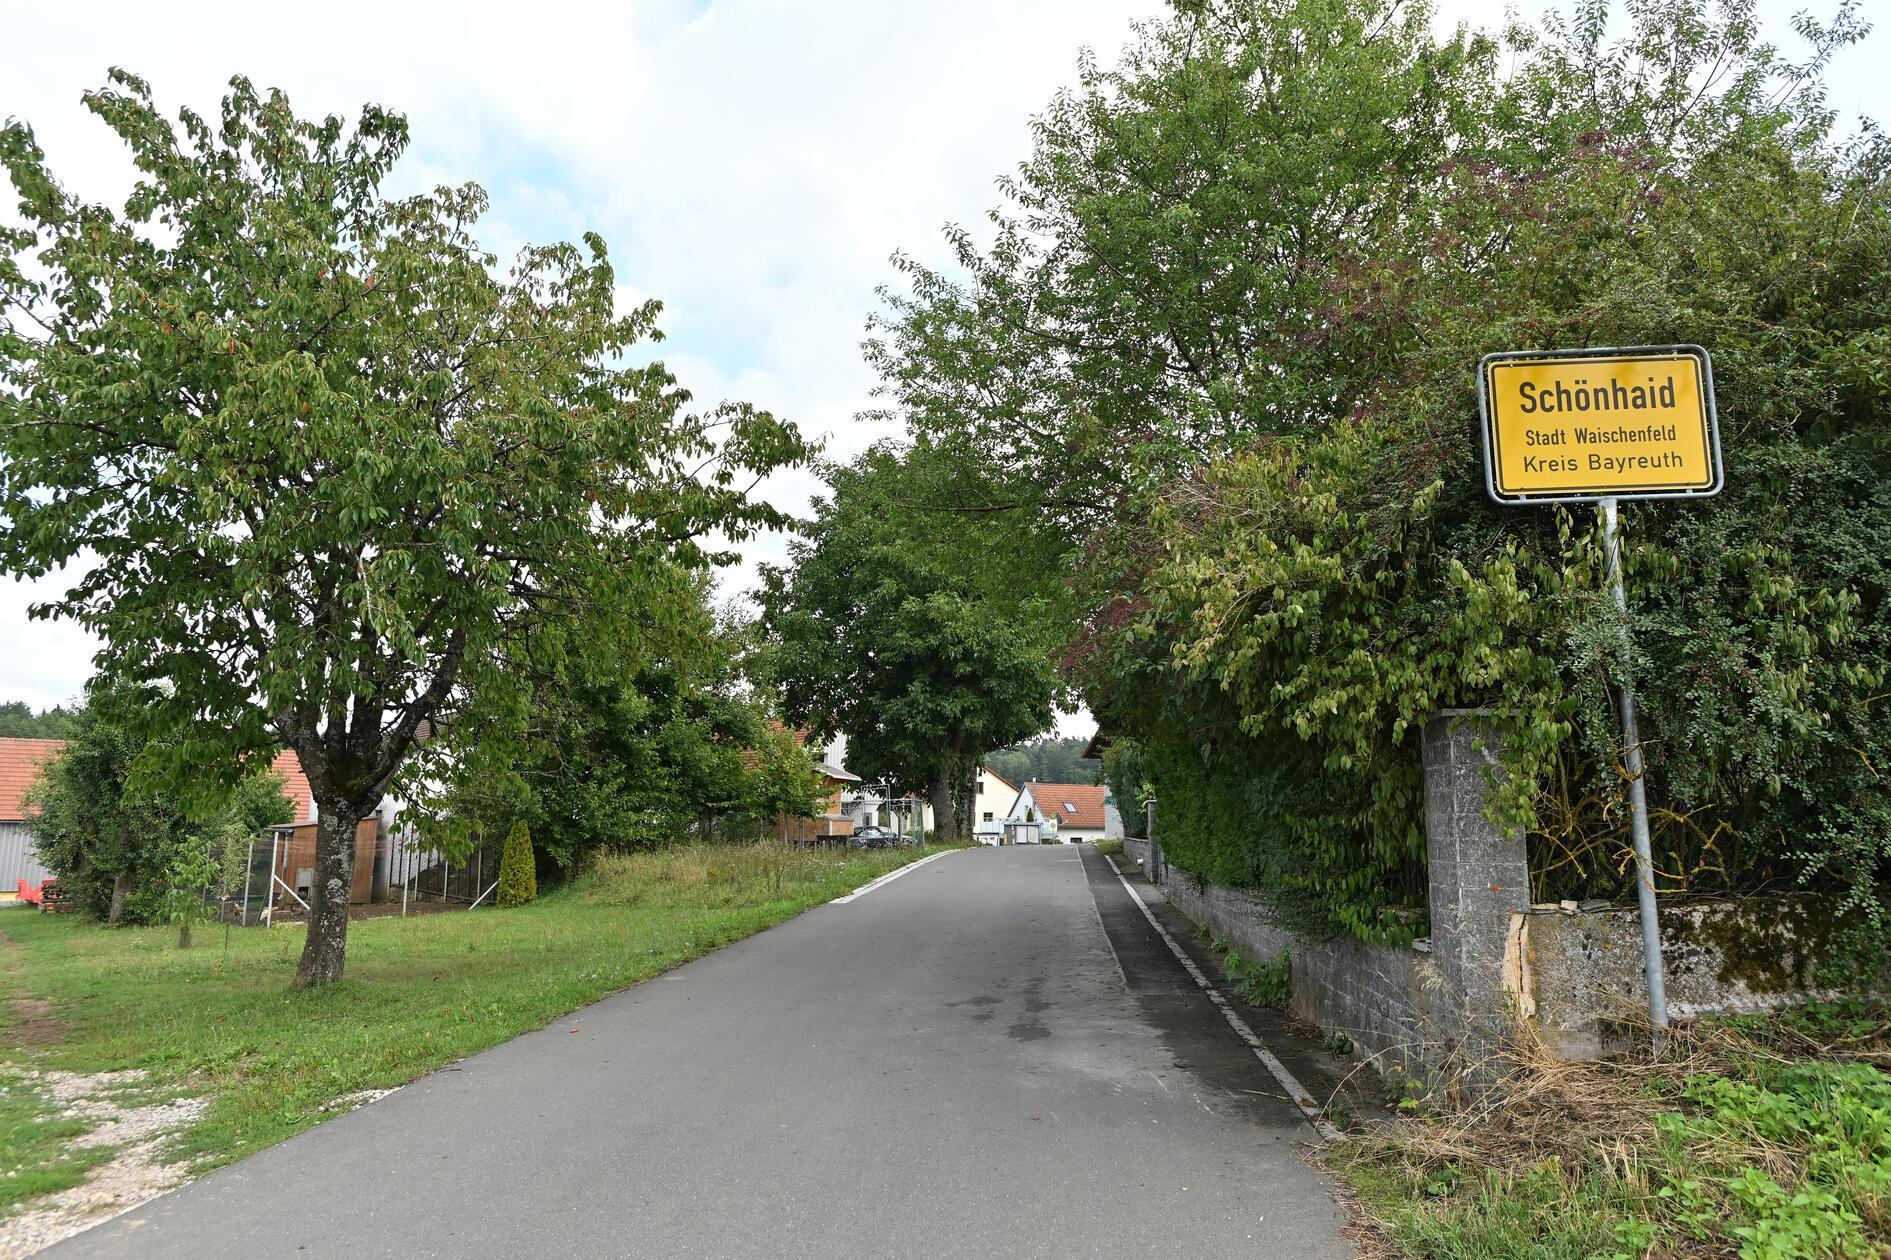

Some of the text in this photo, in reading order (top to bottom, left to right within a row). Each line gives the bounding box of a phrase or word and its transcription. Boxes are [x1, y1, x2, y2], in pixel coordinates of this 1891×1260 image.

[1519, 376, 1676, 414] Schönhaid
[1525, 425, 1676, 446] Stadt Waischenfeld
[1523, 451, 1683, 474] Kreis Bayreuth
